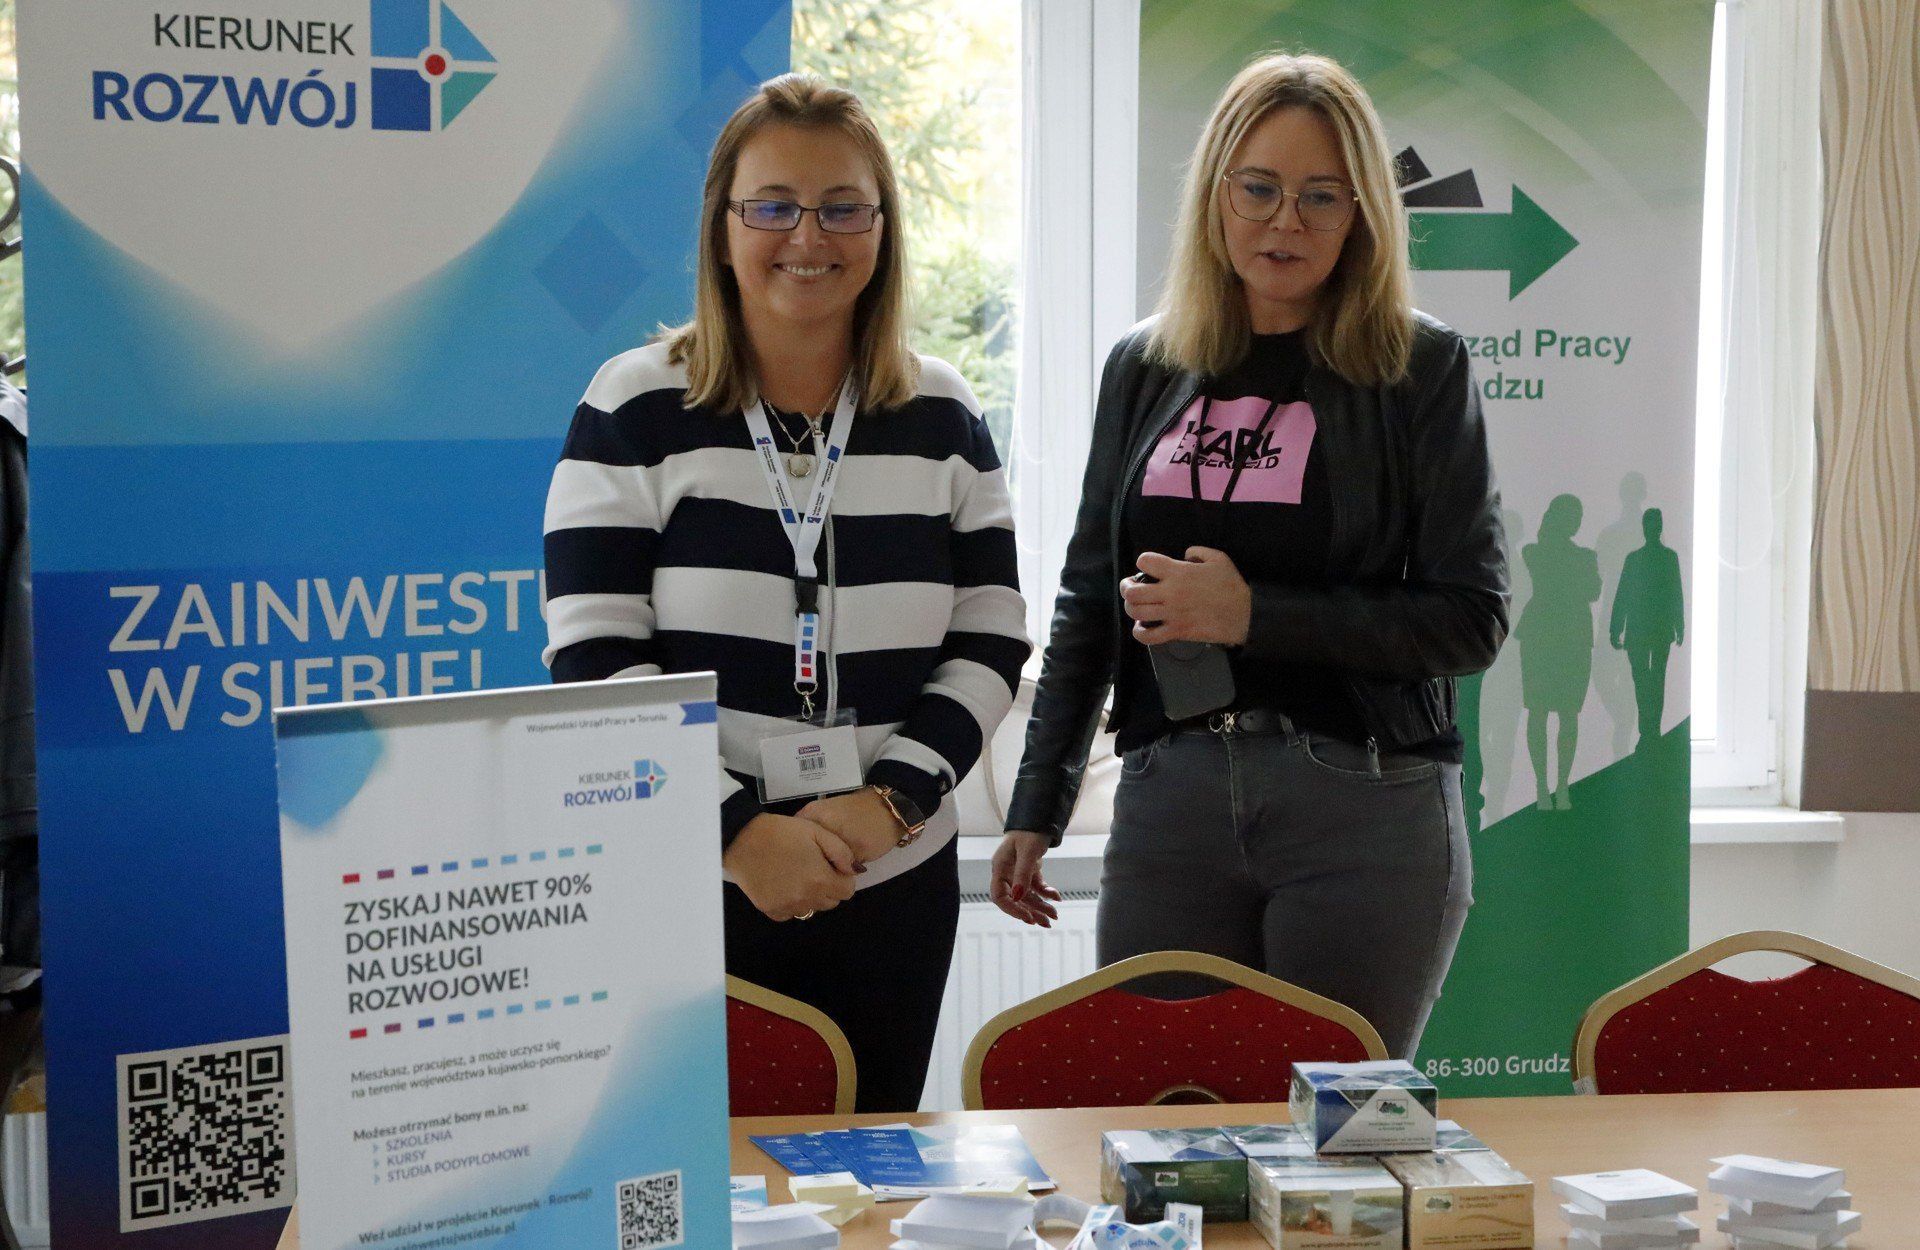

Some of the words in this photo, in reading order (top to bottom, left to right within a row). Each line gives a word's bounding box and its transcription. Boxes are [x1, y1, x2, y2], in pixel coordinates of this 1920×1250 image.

[154, 13, 355, 56] KIERUNEK
[92, 69, 357, 129] ROZWÓJ
[1465, 329, 1522, 365] ząd
[1535, 329, 1632, 365] Pracy
[1483, 372, 1544, 400] dzu
[1177, 420, 1283, 462] KARL
[108, 568, 547, 653] ZAINWEST
[107, 664, 202, 734] W
[578, 716, 604, 729] Urząd
[604, 715, 628, 728] Pracy
[628, 717, 637, 725] w
[563, 785, 633, 808] ROZWÓJ
[578, 770, 632, 785] KIERUNEK
[344, 892, 441, 926] ZYSKAJ
[447, 880, 539, 911] NAWET
[544, 873, 593, 899] 90%
[345, 902, 589, 955] DOFINANSOWANIA
[347, 959, 386, 985] NA
[391, 945, 483, 978] USŁUGI
[348, 966, 530, 1015] ROZWOJOWE!
[350, 1064, 411, 1083] Mieszkasz,
[412, 1056, 467, 1076] pracujesz,
[468, 1056, 477, 1065] a
[478, 1048, 509, 1063] może
[509, 1042, 544, 1060] uczysz
[545, 1039, 561, 1054] się
[351, 1088, 366, 1100] na
[368, 1080, 407, 1097] terenie
[409, 1066, 486, 1090] województwa
[487, 1044, 612, 1078] kujawsko-pomorskiego?
[1425, 1057, 1500, 1078] 86-300
[1505, 1052, 1571, 1075] Grudz
[353, 1125, 398, 1142] Możesz
[399, 1114, 453, 1133] otrzymać
[454, 1111, 482, 1126] bony
[485, 1106, 511, 1119] m.in.
[512, 1102, 529, 1114] na:
[385, 1130, 453, 1152] SZKOLENIA
[387, 1150, 427, 1167] KURSY
[387, 1166, 432, 1183] STUDIA
[434, 1145, 531, 1174] PODYPLOMOWE
[387, 1221, 422, 1239] udział
[424, 1222, 435, 1231] w
[490, 1199, 541, 1218] Kierunek
